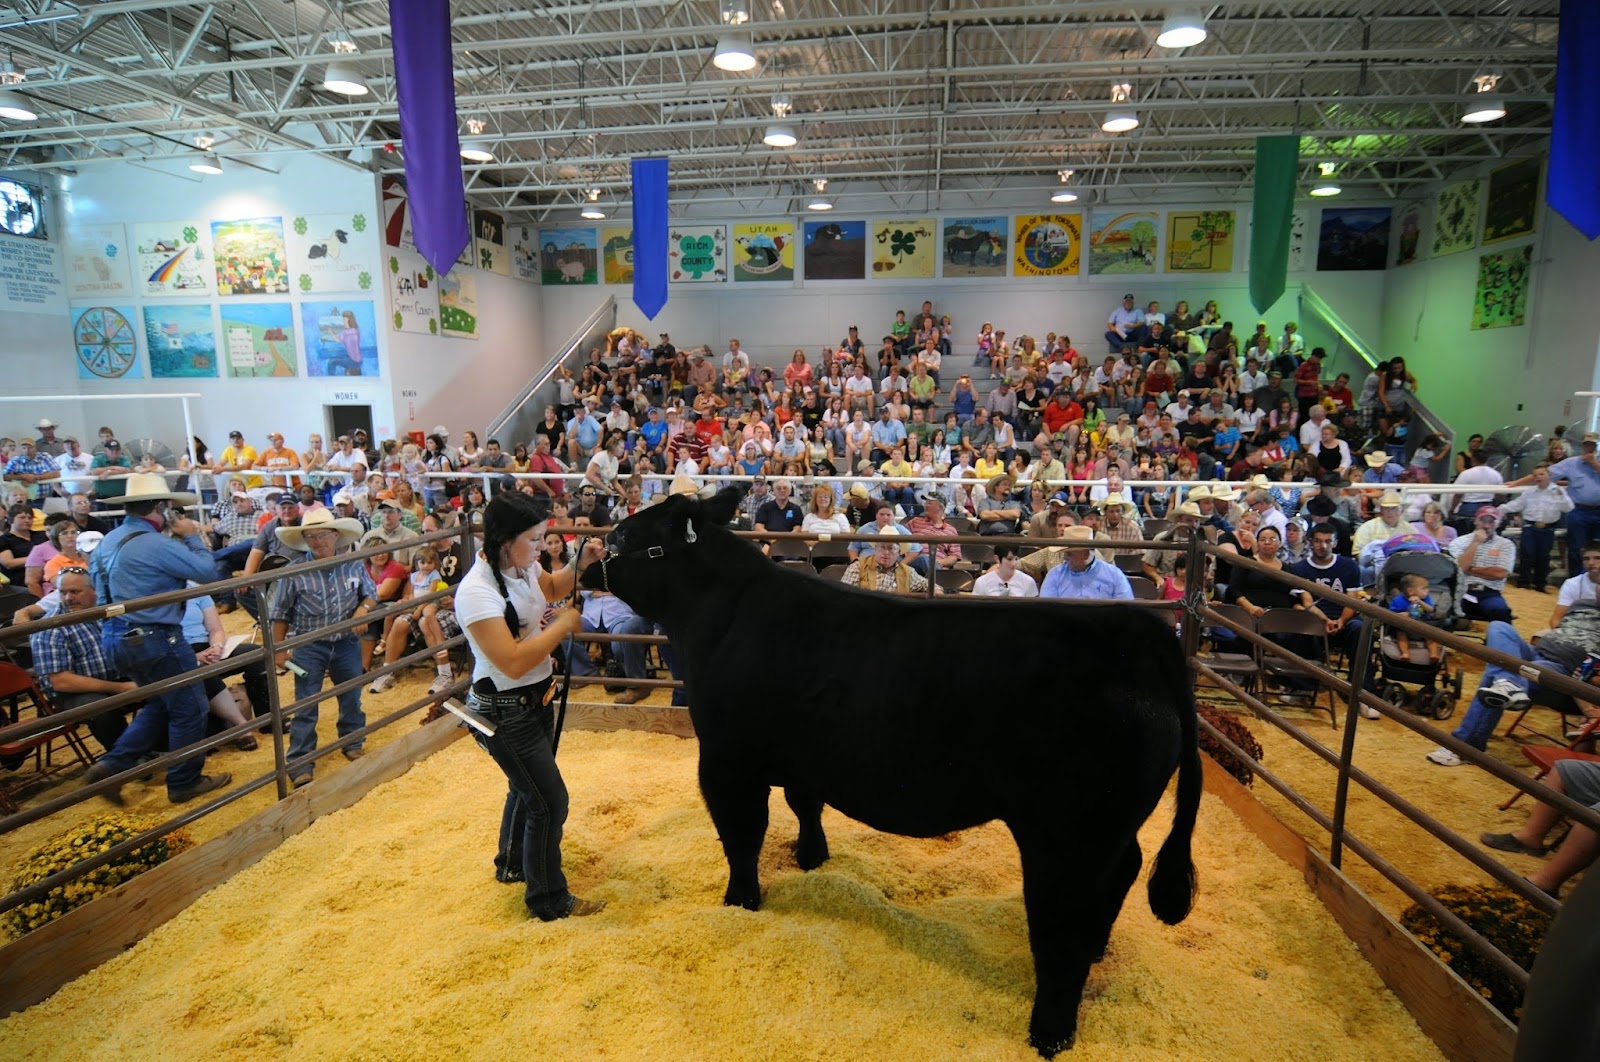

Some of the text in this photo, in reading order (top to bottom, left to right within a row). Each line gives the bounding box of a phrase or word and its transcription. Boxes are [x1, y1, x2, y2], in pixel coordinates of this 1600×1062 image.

[1015, 223, 1030, 243] WHEEL
[1029, 216, 1037, 224] OF
[8, 240, 24, 248] UTAH
[24, 243, 41, 252] STATE
[42, 246, 55, 254] FAIR
[686, 242, 708, 250] RICH
[0, 246, 52, 260] WISHES TO THANK
[1, 252, 13, 260] THE
[681, 256, 713, 265] COUNTY
[1017, 256, 1069, 276] WASHINGTON
[2, 265, 55, 278] JUNIOR LIVESTOCK
[334, 391, 359, 401] WOMEN
[402, 390, 417, 398] WOMEN
[1307, 577, 1344, 594] SA
